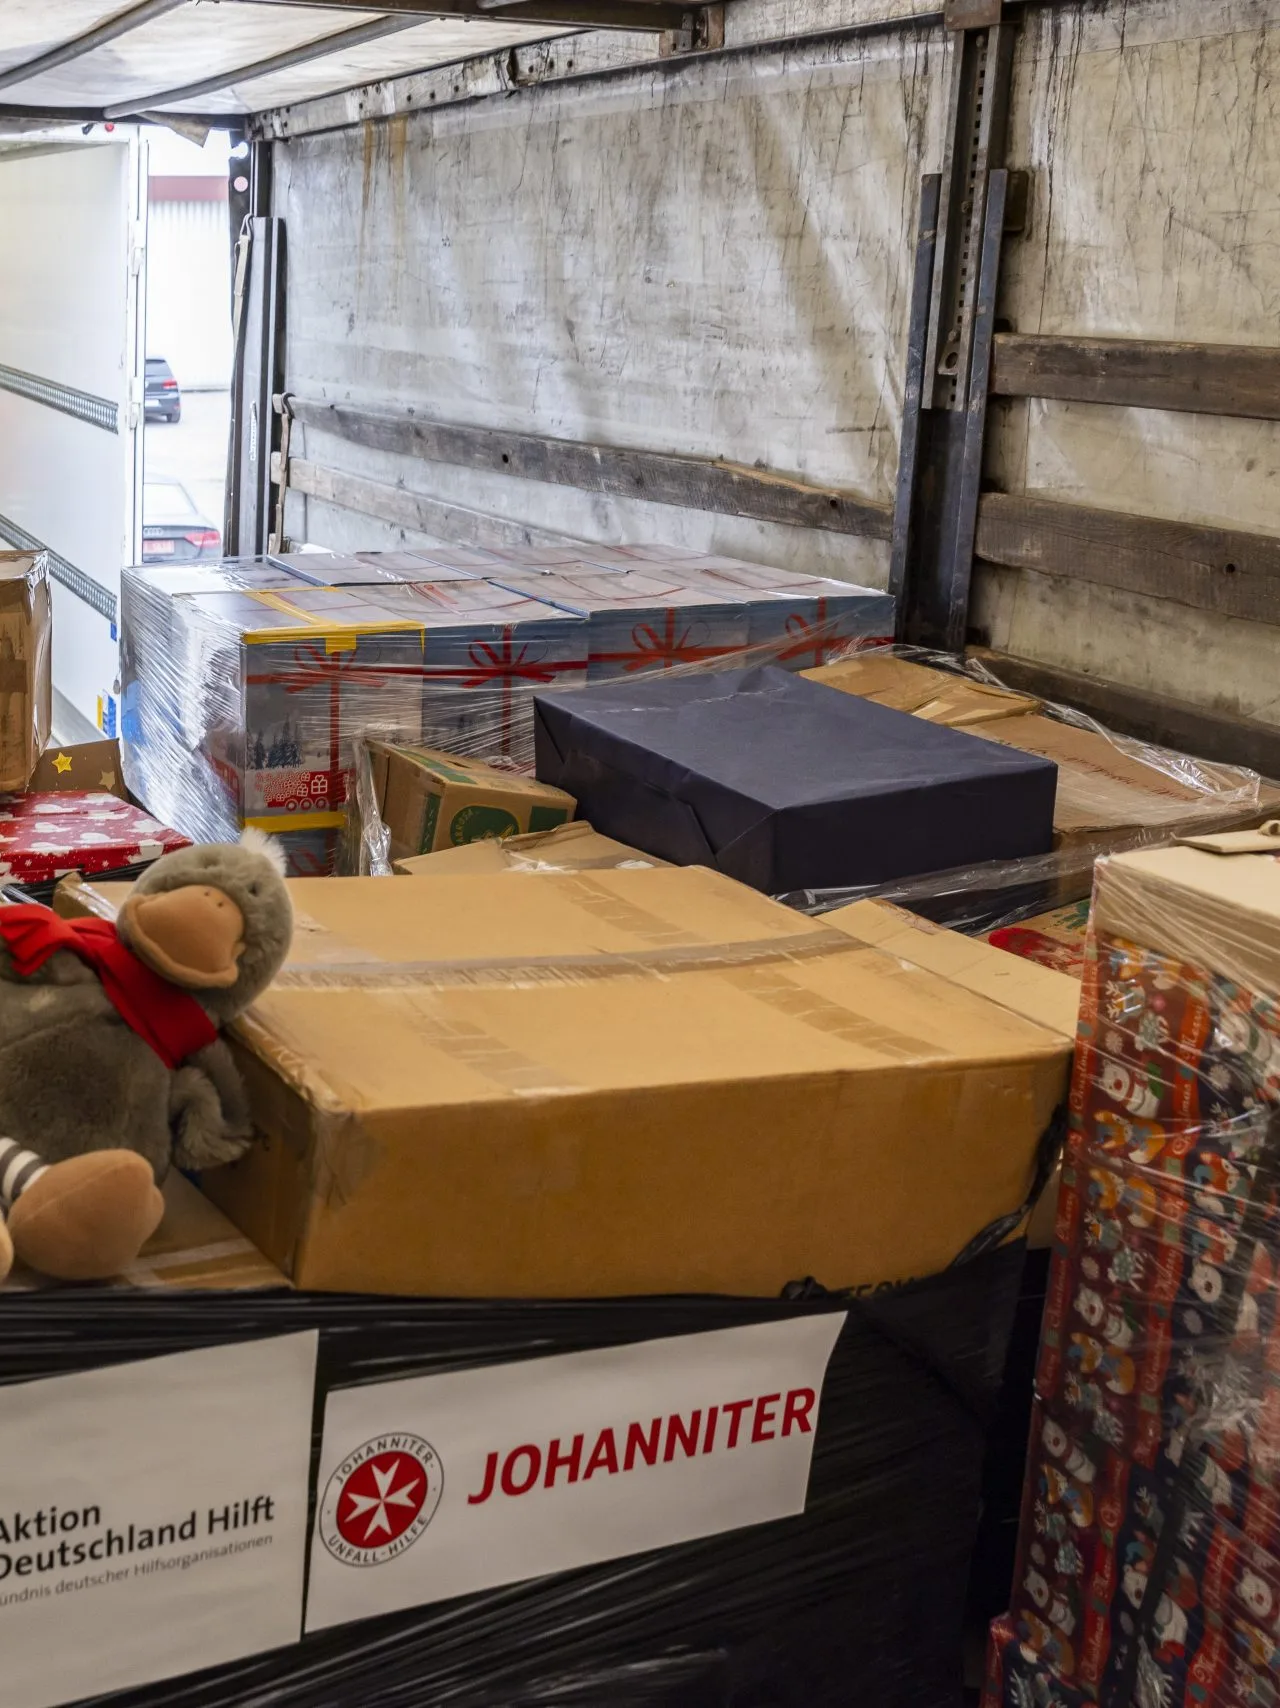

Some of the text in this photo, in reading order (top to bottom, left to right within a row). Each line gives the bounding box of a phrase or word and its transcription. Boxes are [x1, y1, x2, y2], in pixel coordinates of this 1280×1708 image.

[467, 1387, 816, 1506] JOHANNITER
[208, 1496, 274, 1536] Hilft
[55, 1566, 130, 1595] deutscher
[133, 1535, 273, 1577] Hilfsorganisationen
